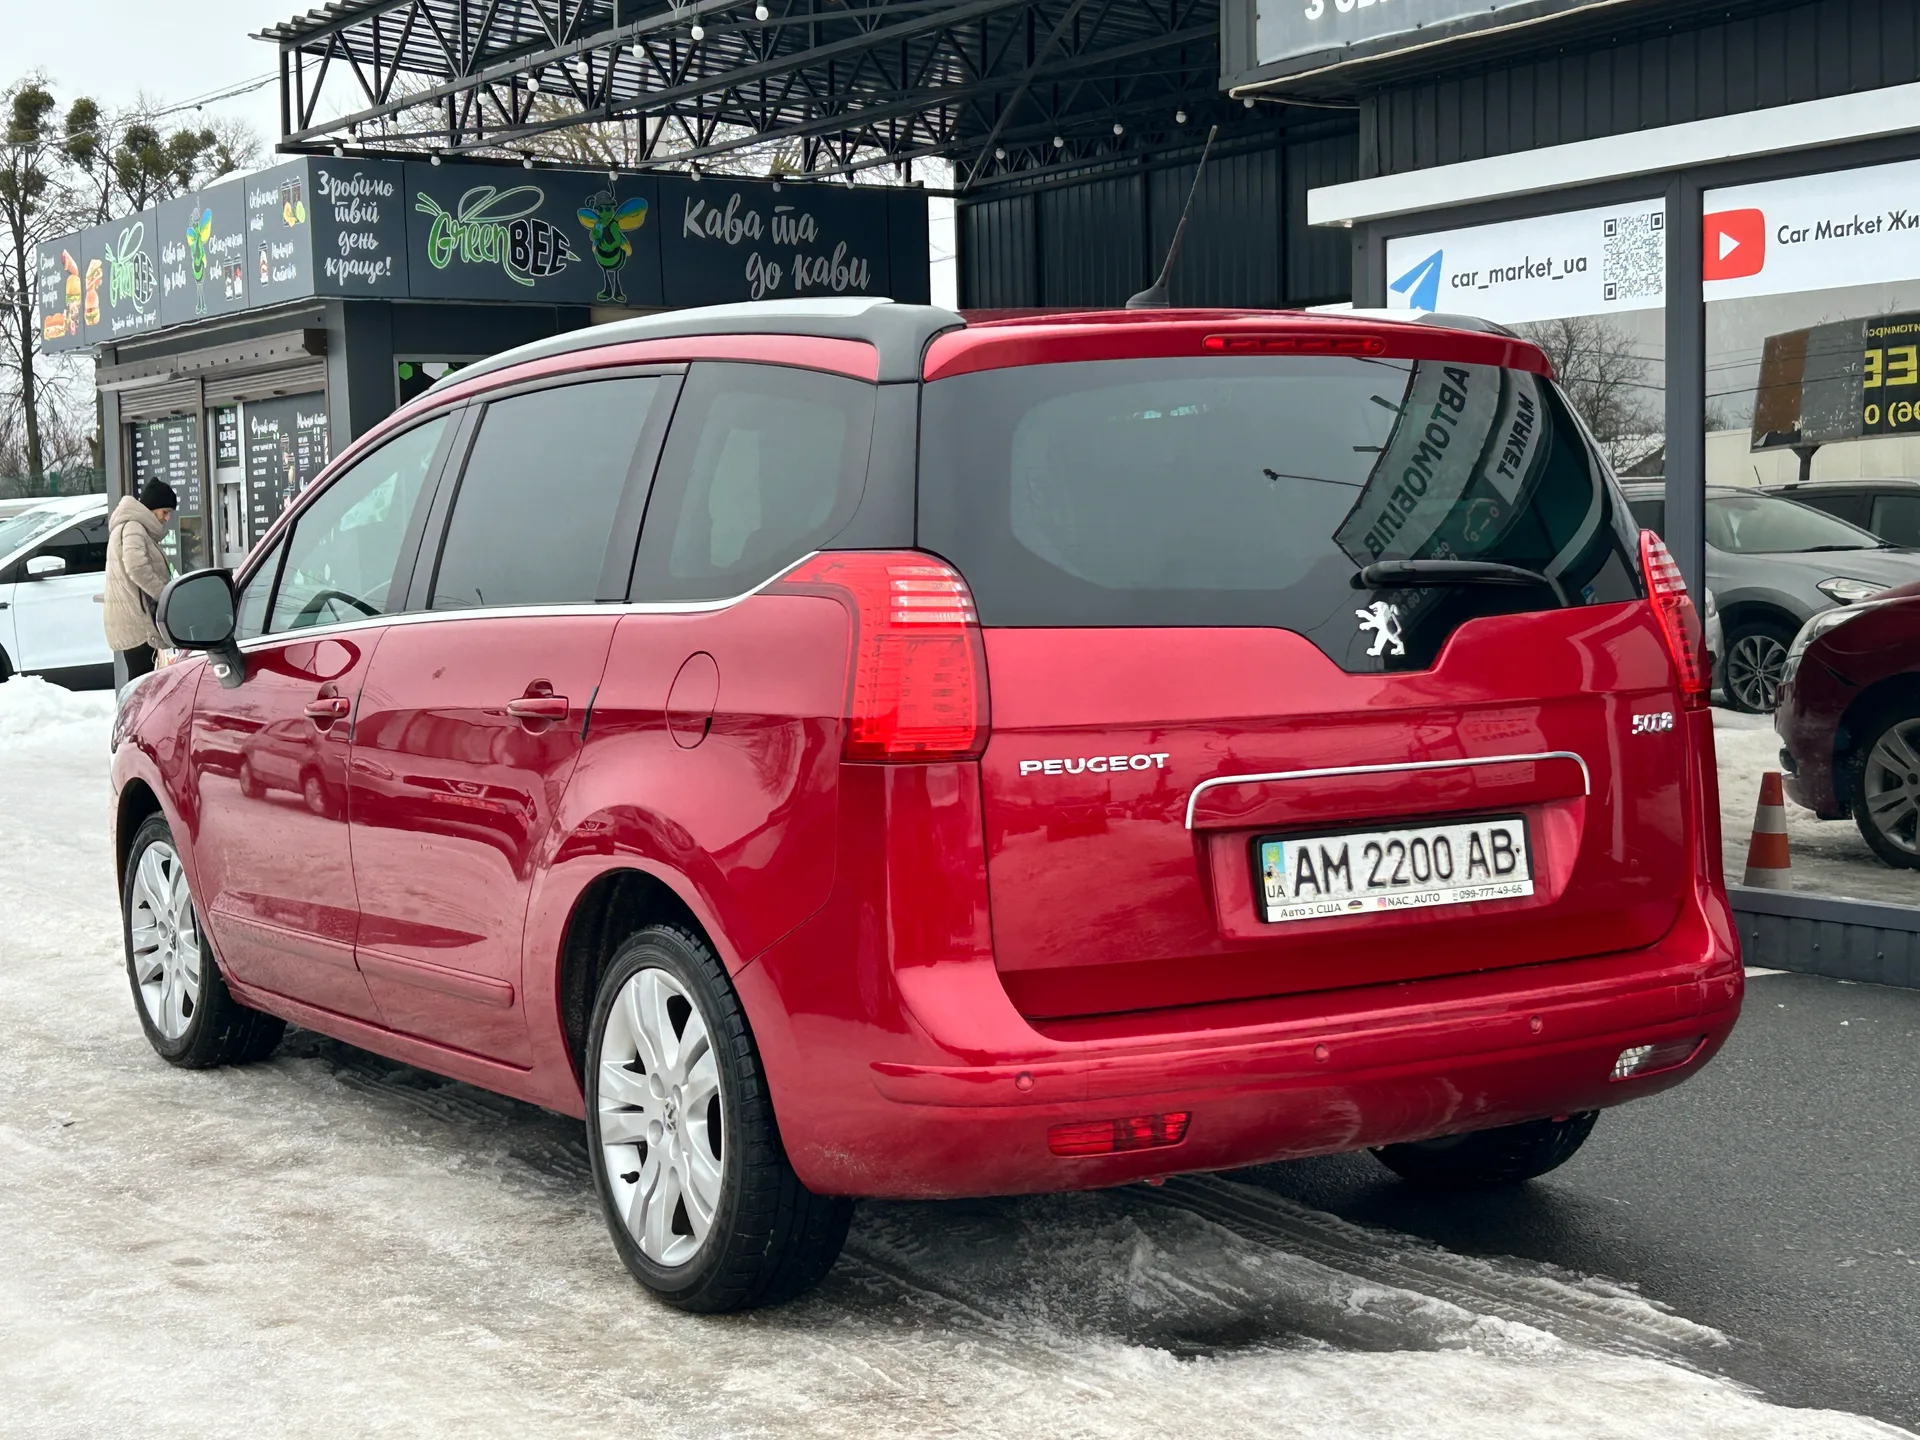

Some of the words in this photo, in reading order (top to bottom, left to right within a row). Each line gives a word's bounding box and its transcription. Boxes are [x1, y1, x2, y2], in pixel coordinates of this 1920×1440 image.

[318, 170, 394, 205] Зробимо
[334, 197, 380, 224] твій
[683, 193, 764, 245] Кава
[771, 205, 819, 246] та
[1777, 224, 1810, 245] Car
[1814, 213, 1883, 241] Market
[1887, 209, 1920, 232] Жи
[338, 231, 379, 256] день
[324, 256, 391, 286] краще!
[745, 252, 783, 300] до
[791, 240, 872, 292] кави
[1451, 256, 1588, 290] car_market_ua
[1632, 712, 1673, 735] 5008
[1019, 753, 1170, 777] PEUGEOT
[1294, 842, 1353, 897] AM
[1364, 834, 1454, 889] 2200
[1468, 828, 1517, 881] AB
[1266, 885, 1286, 899] UA
[1387, 893, 1441, 907] NAC_AUTO
[1280, 908, 1306, 918] Авто
[1316, 903, 1342, 914] США
